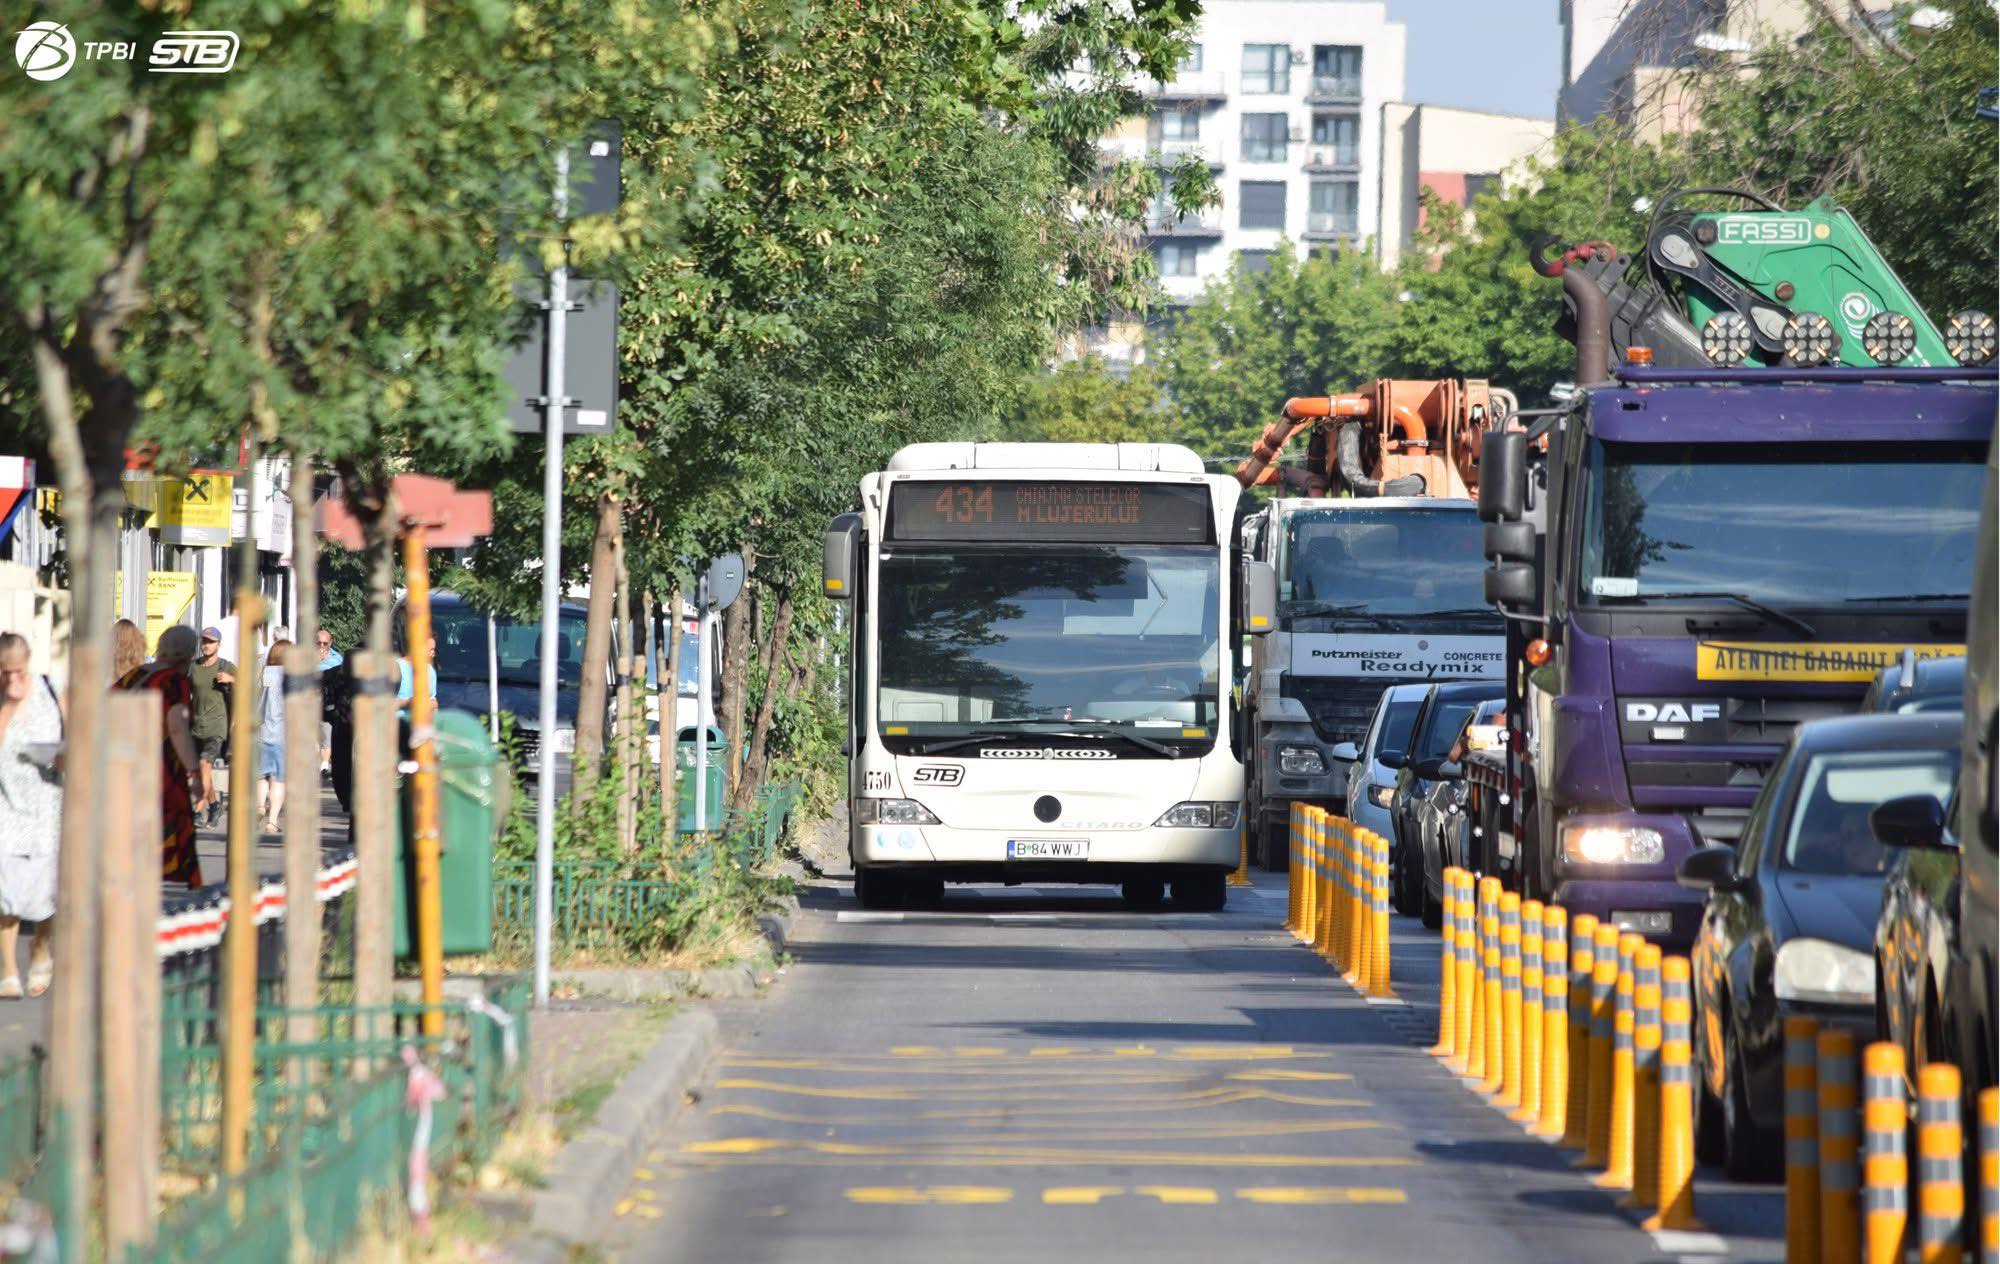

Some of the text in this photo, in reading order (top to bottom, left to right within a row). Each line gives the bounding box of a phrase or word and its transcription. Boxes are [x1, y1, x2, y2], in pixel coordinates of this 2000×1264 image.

[1725, 222, 1804, 240] FASSI
[935, 486, 993, 523] 434
[1076, 487, 1142, 505] STELELOR
[1017, 505, 1140, 523] M LUJERULUI
[1312, 650, 1402, 660] Putzmeister
[1443, 652, 1502, 661] CONCRETE
[1361, 660, 1484, 680] Readymix
[1626, 703, 1720, 722] DAF
[862, 770, 892, 790] 4750
[913, 768, 960, 782] STB
[1061, 820, 1143, 829] CITARO
[1016, 843, 1081, 856] B 84 WWJ
